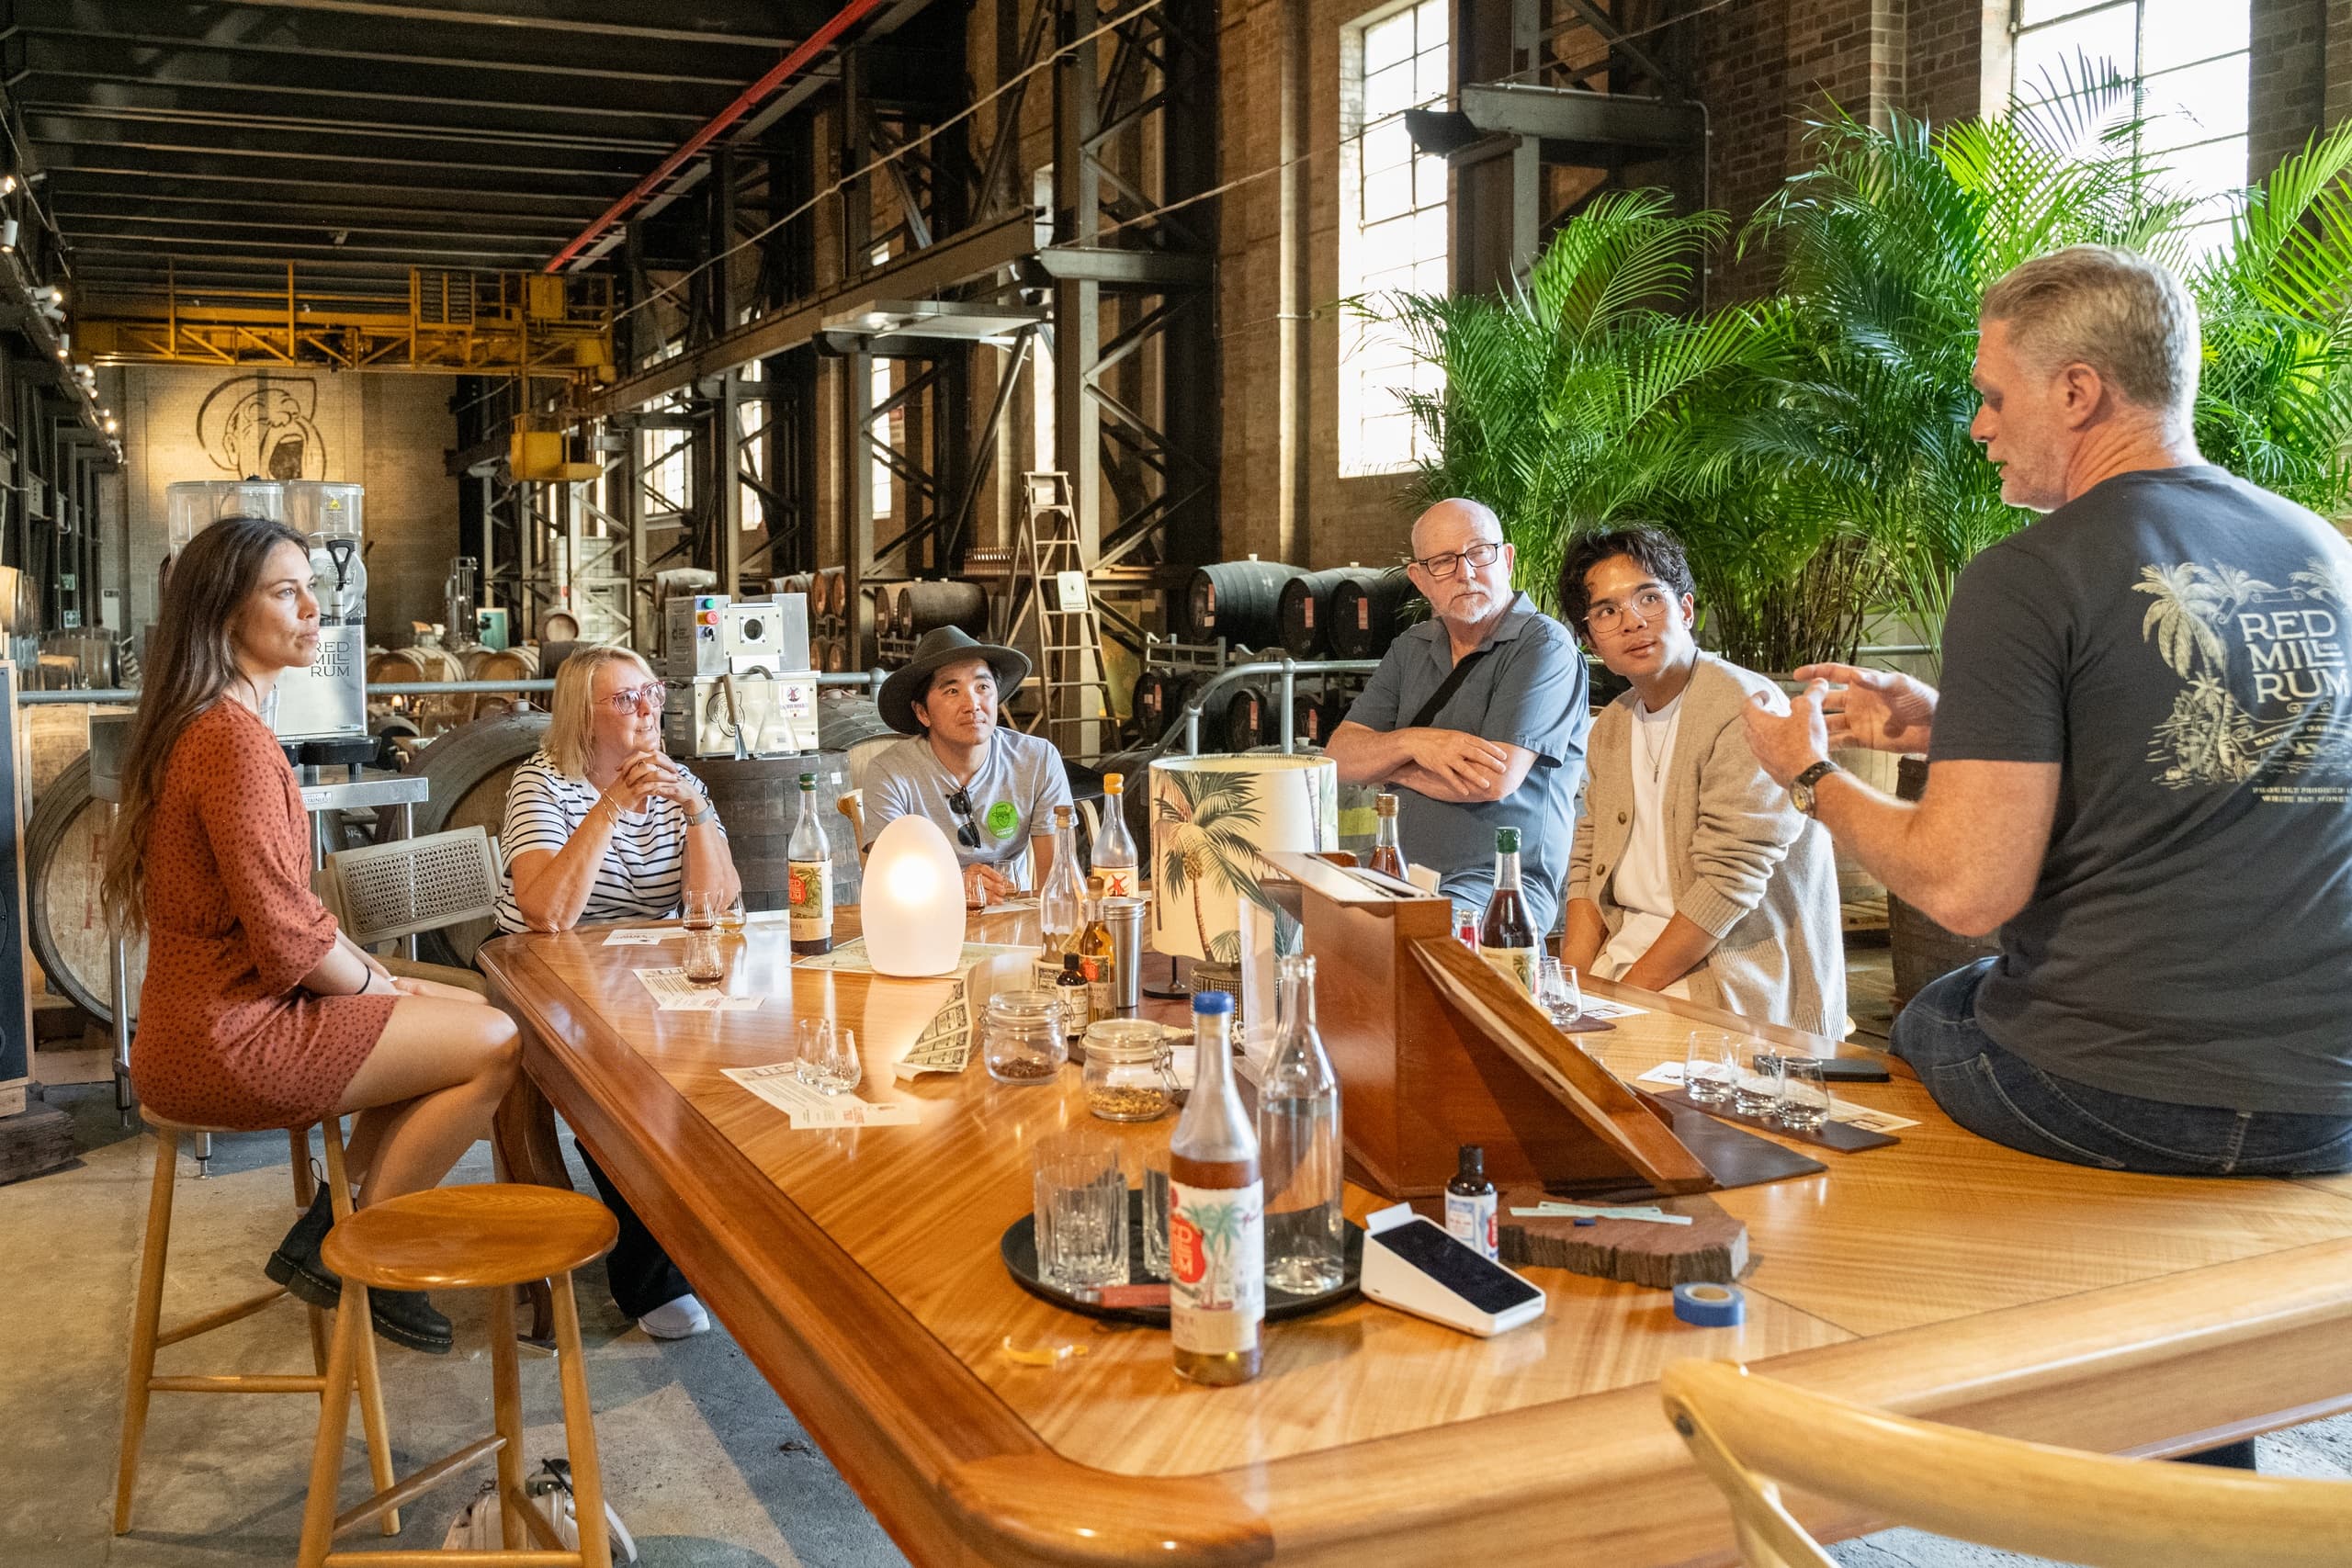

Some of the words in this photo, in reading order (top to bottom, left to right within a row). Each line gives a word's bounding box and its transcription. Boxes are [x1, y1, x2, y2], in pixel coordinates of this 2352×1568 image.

[2237, 610, 2336, 642] RED
[311, 665, 350, 677] RUM
[2245, 639, 2346, 671] MILL
[2253, 668, 2350, 704] RUM
